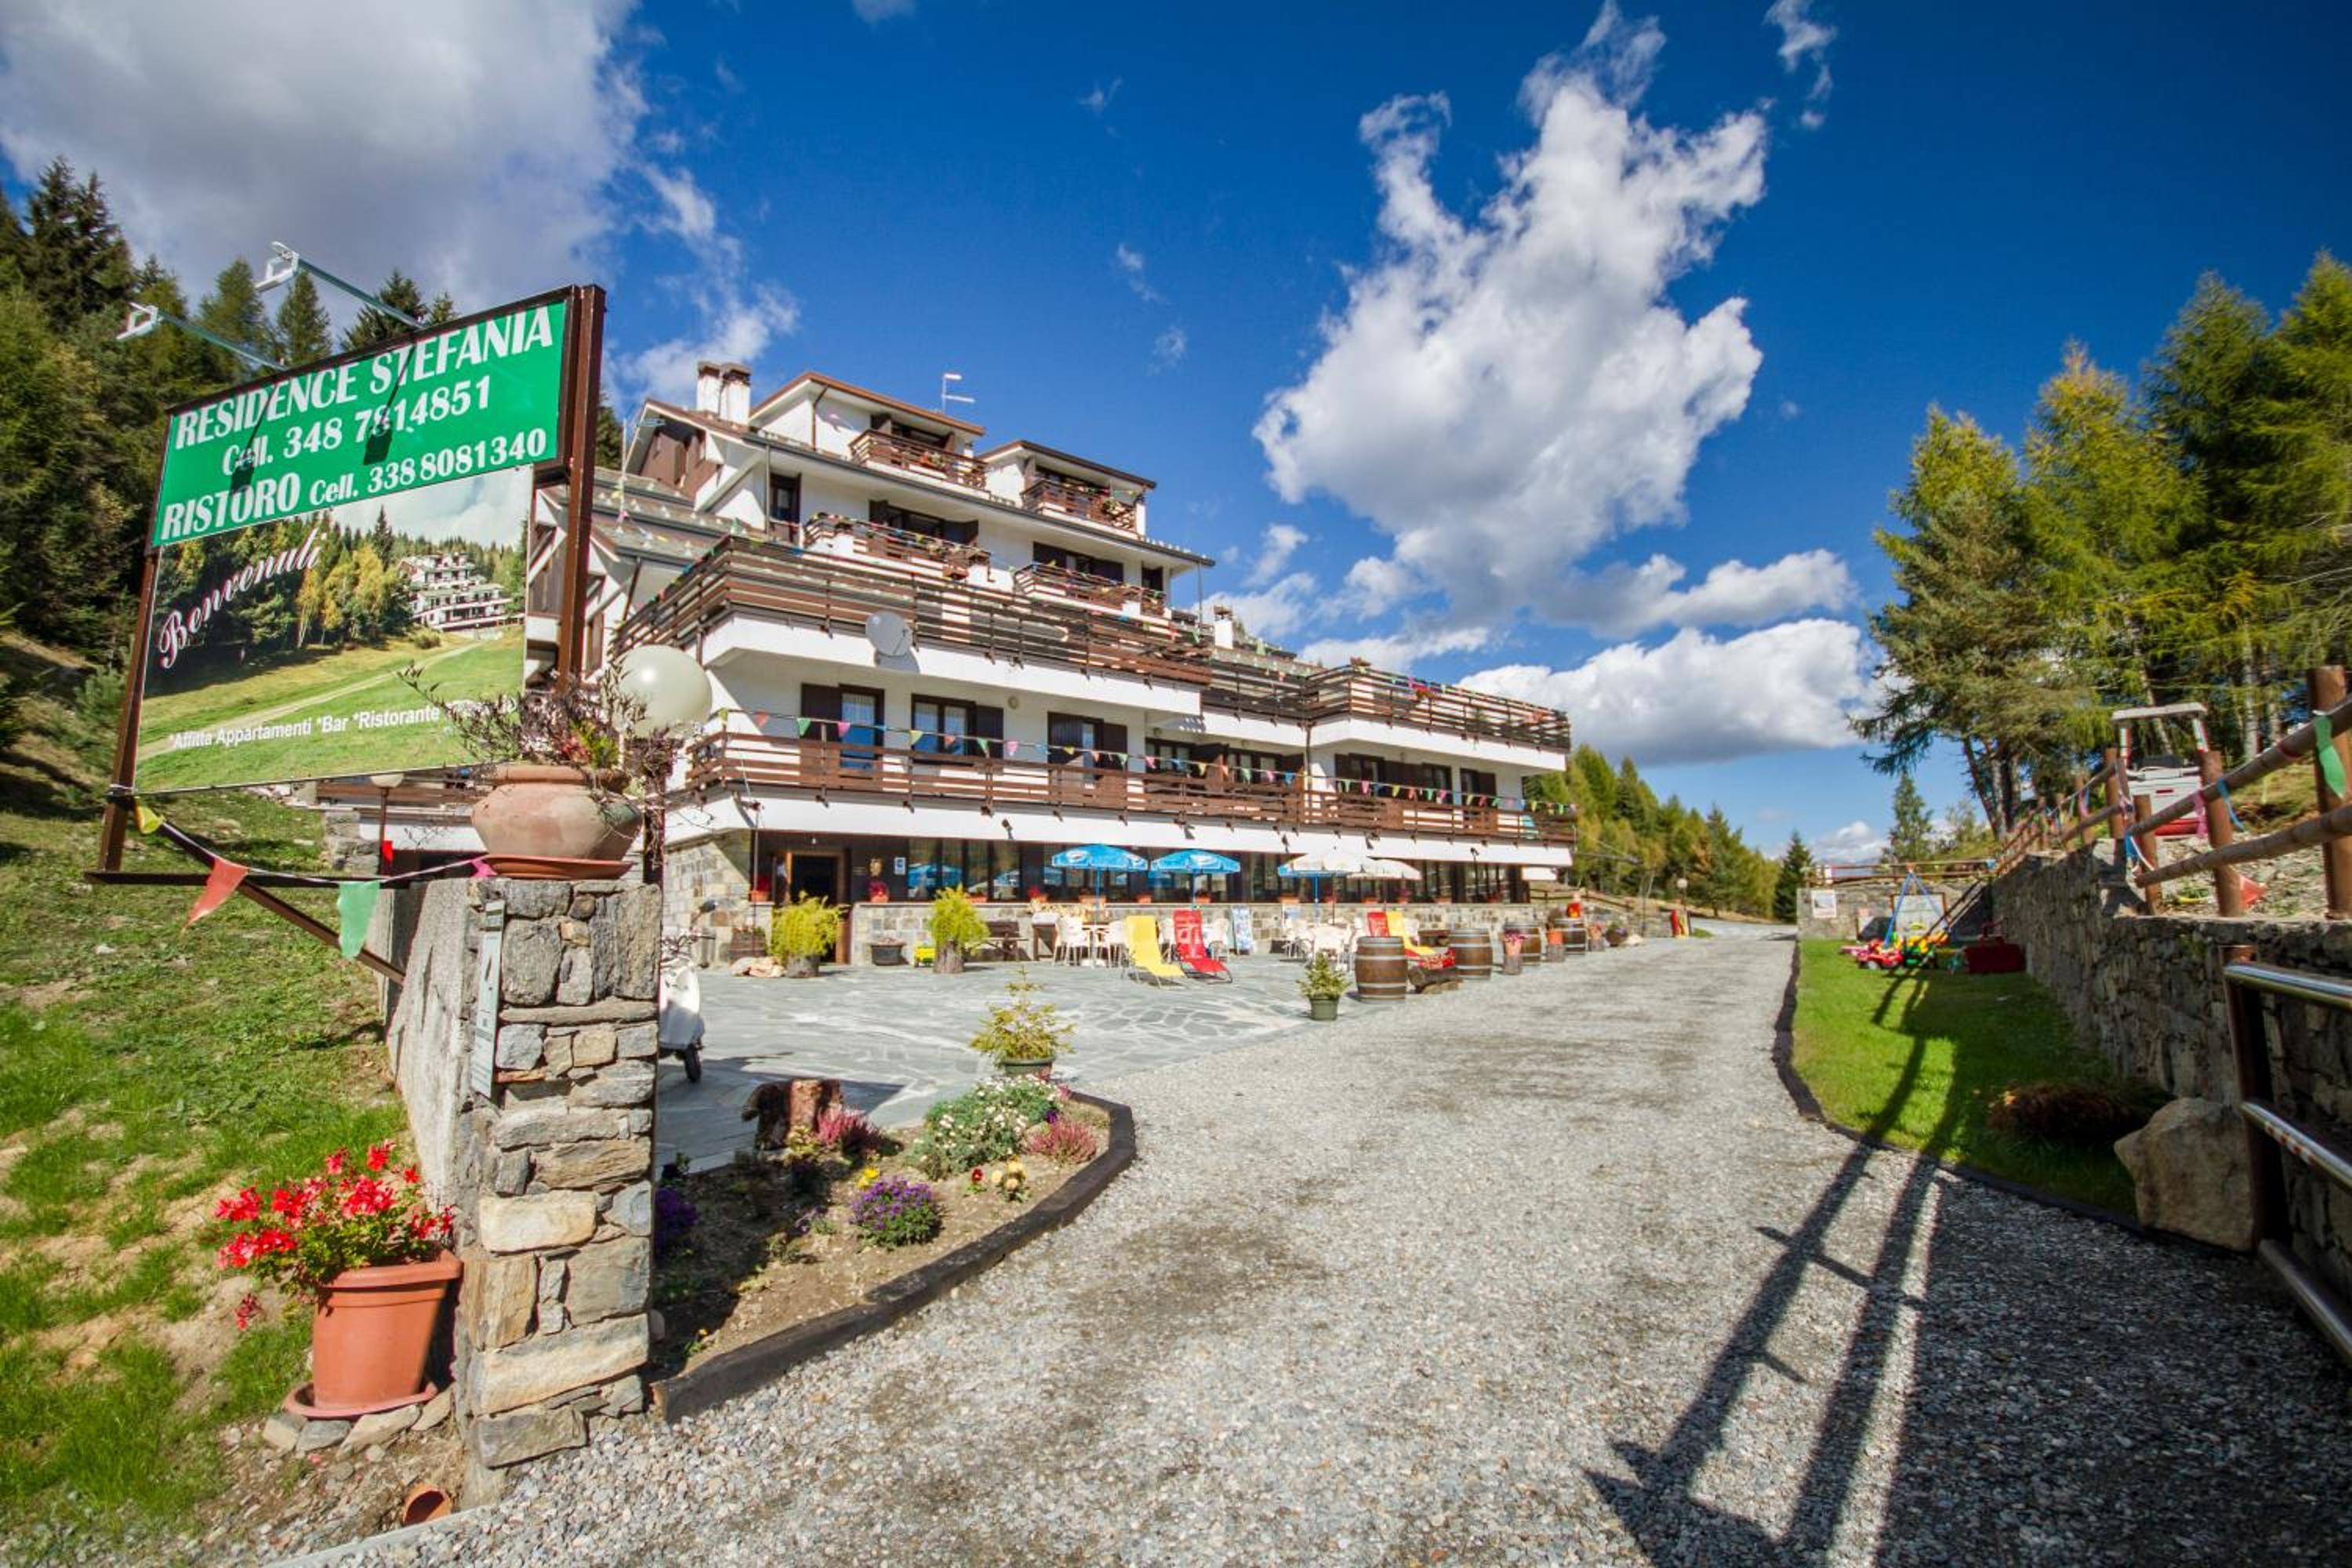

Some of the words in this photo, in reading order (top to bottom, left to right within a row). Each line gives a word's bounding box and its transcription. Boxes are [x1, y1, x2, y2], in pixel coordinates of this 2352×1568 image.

[175, 361, 358, 450] RESIDENCE
[368, 305, 554, 394] STEFANIA
[223, 434, 274, 476] Cell.
[283, 416, 343, 459] 348
[354, 374, 490, 443] 7814851
[161, 471, 301, 541] RISTORO
[309, 472, 359, 506] Cell.
[367, 457, 416, 493] 338
[419, 426, 547, 481] 8081340
[159, 526, 328, 669] Benvenuti
[216, 717, 313, 748] Appartamenti
